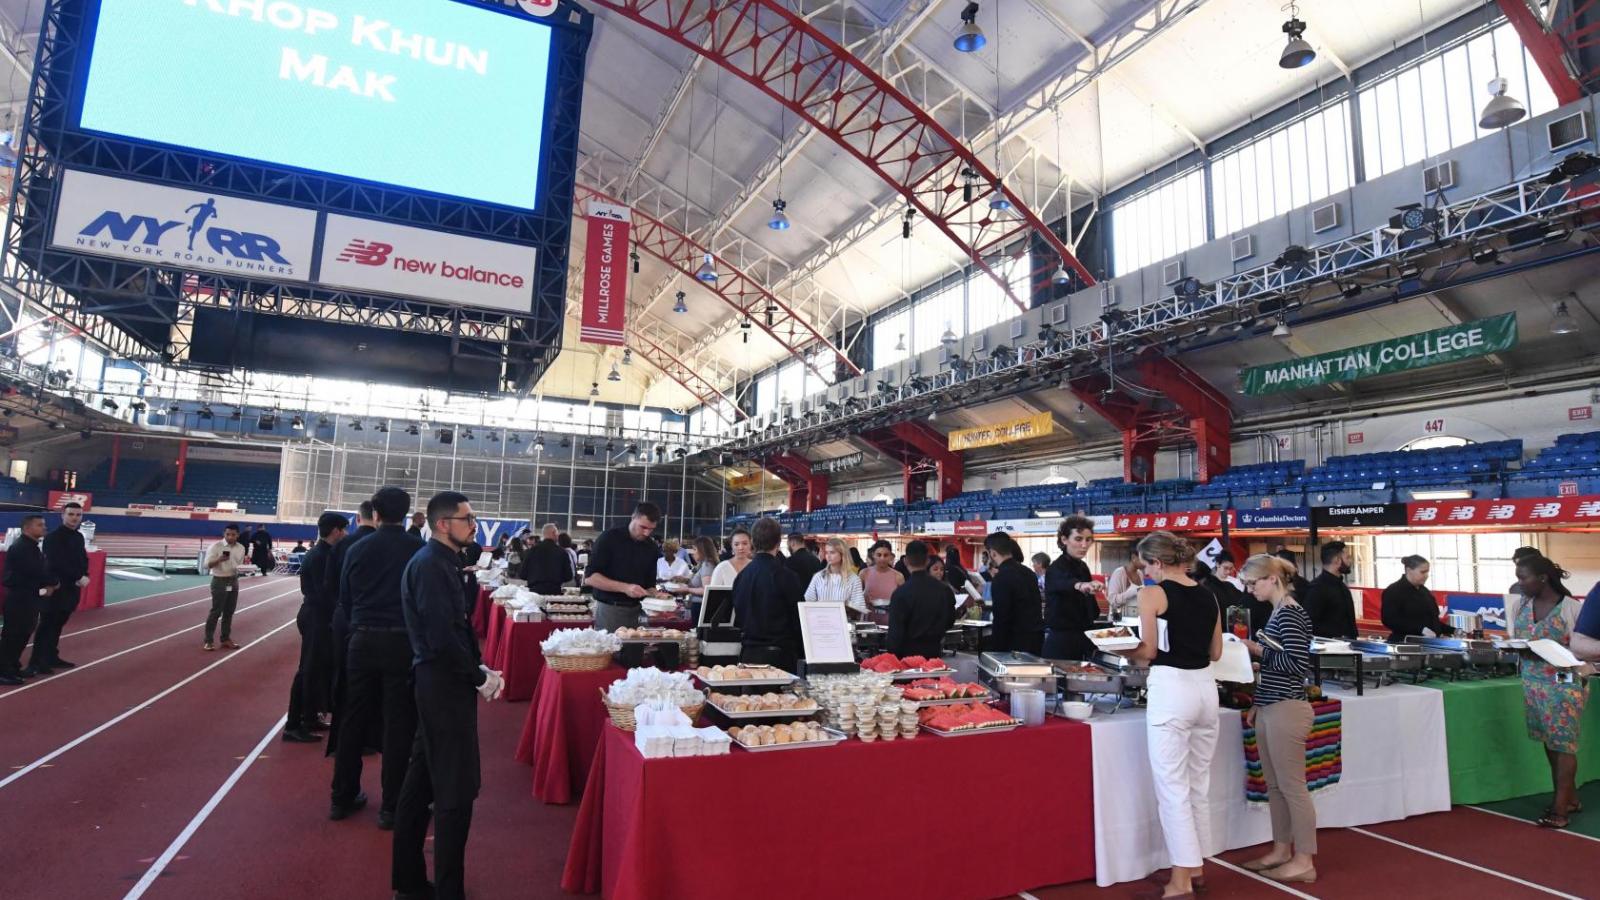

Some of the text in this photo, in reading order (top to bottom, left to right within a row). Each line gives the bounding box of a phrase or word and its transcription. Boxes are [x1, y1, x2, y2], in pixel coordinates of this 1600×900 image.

[351, 15, 488, 75] KHUN
[278, 47, 397, 101] MAK
[76, 237, 294, 275] NEW YORK ROAD RUNNERS
[393, 256, 525, 289] new balance
[597, 223, 614, 323] MILLROSE GAMES
[1264, 327, 1484, 385] MANHATTAN COLLEGE
[1424, 419, 1444, 433] 447
[1560, 485, 1577, 495] EXIT
[1253, 515, 1307, 523] ColumbiaDoctors
